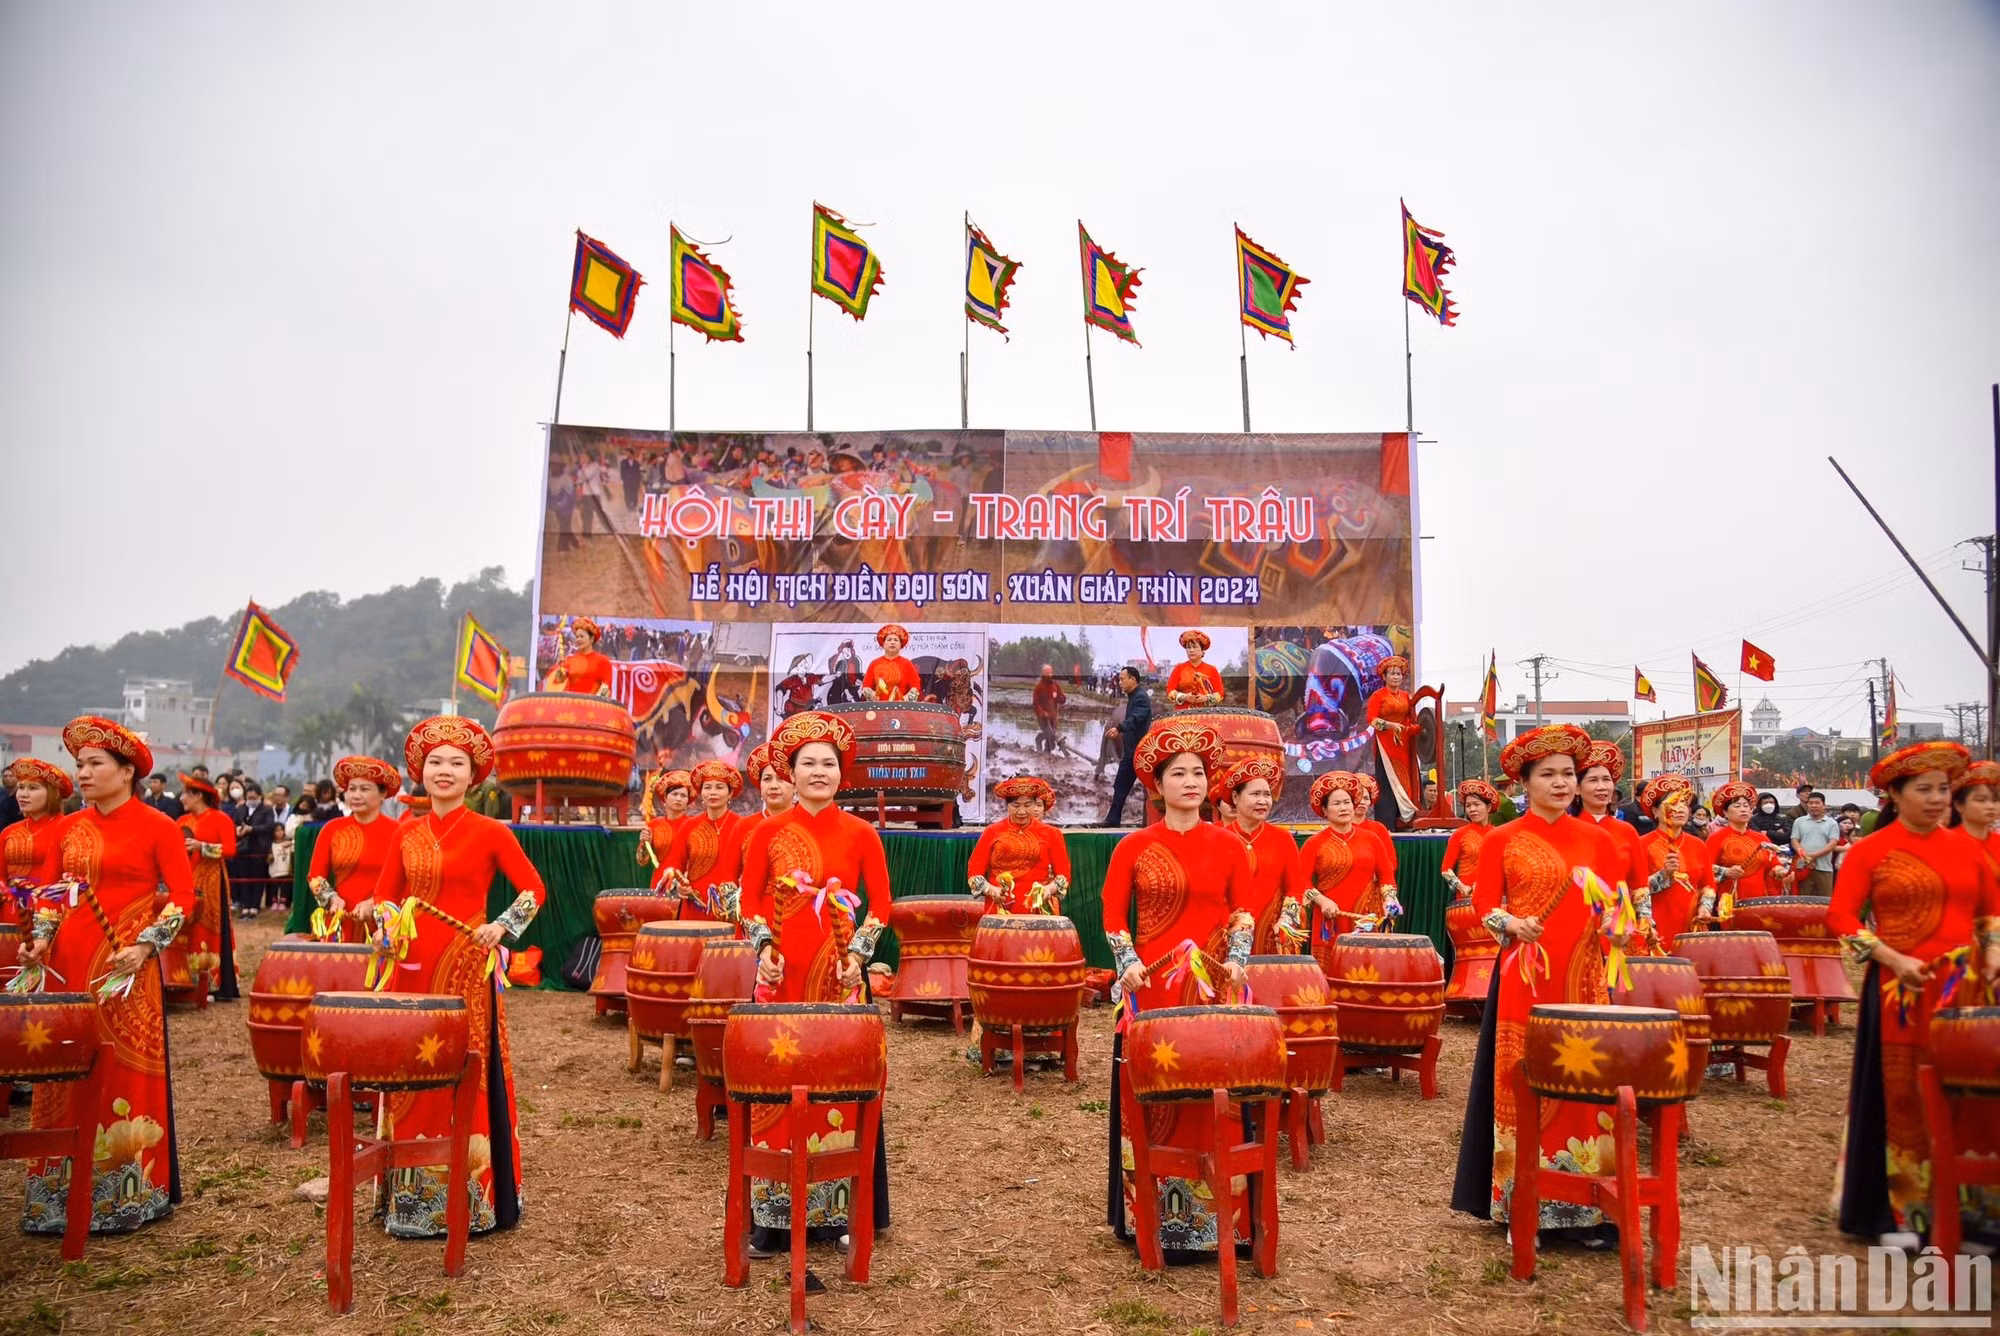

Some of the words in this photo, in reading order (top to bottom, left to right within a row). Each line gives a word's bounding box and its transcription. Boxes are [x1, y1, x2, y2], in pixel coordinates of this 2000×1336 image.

[639, 484, 731, 549] HỘI
[749, 496, 814, 541] THI
[833, 486, 918, 540] CÀY
[969, 492, 1107, 541] TRANG
[1124, 485, 1192, 542] TRÍ
[1205, 485, 1315, 543] TRÂU
[691, 563, 720, 601] LỄ
[726, 569, 769, 607] HỘI
[775, 574, 827, 607] TỊCH
[833, 563, 888, 601] ĐIỀN
[894, 573, 936, 607] ĐỌI
[942, 570, 988, 601] SƠN
[1009, 570, 1073, 602] XUÂN
[1080, 570, 1130, 602] GIÁP
[1137, 571, 1192, 603] THÌN
[1200, 576, 1259, 604] 2024
